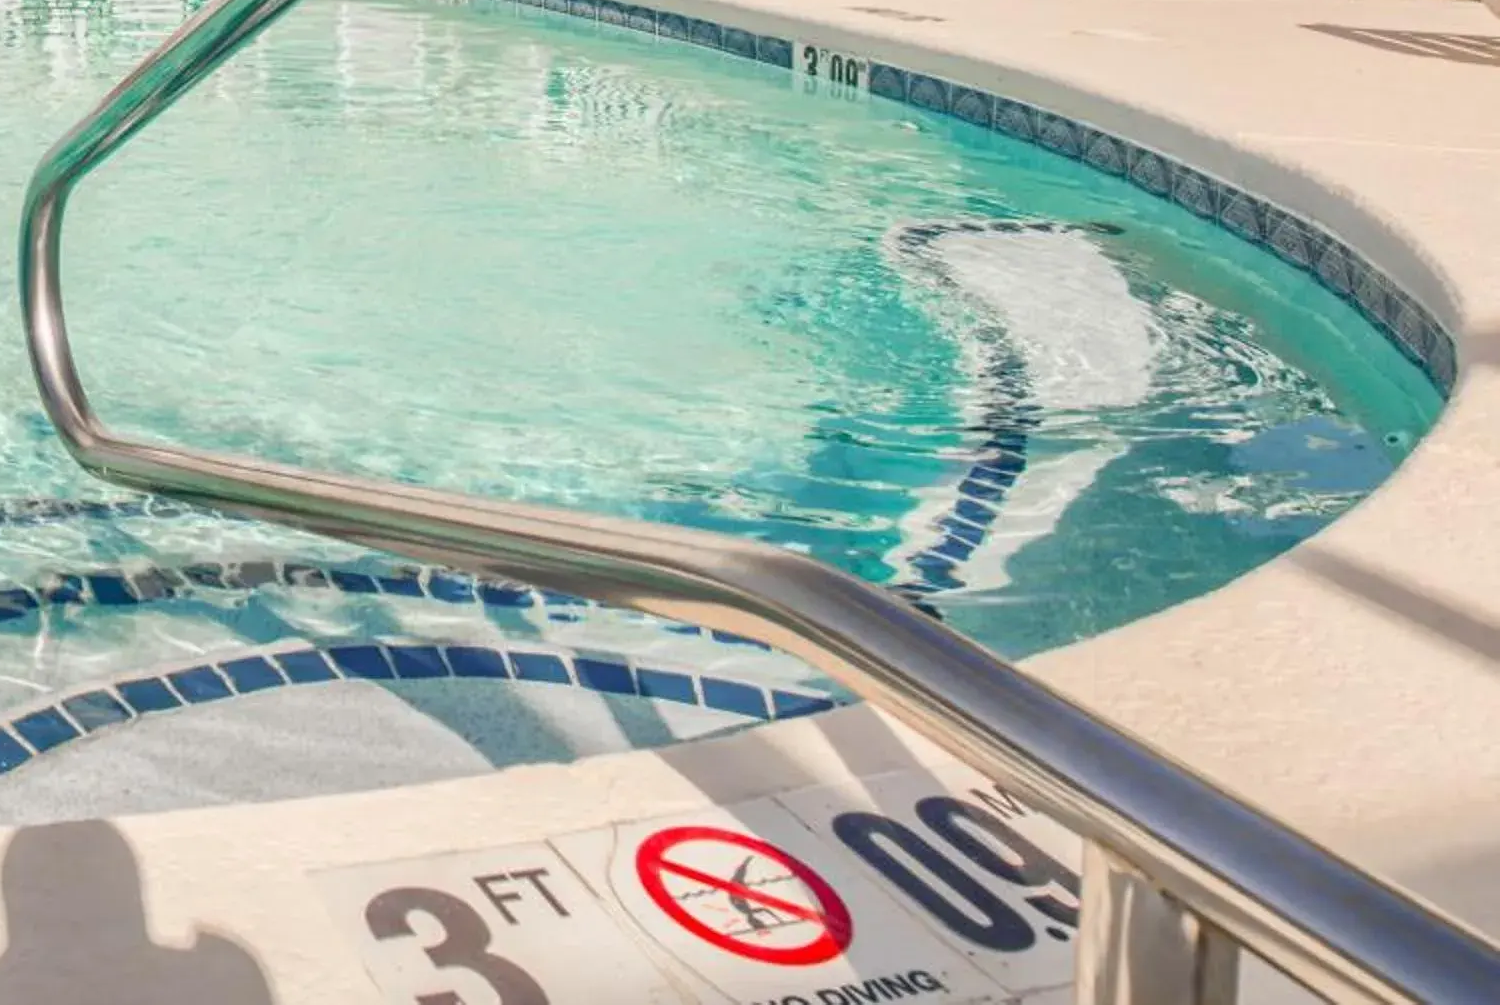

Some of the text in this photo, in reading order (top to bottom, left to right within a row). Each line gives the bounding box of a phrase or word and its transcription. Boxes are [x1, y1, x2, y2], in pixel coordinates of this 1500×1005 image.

[364, 887, 552, 1005] 3
[472, 867, 571, 926] FT
[969, 783, 1027, 820] M
[815, 970, 949, 1005] DIVING
